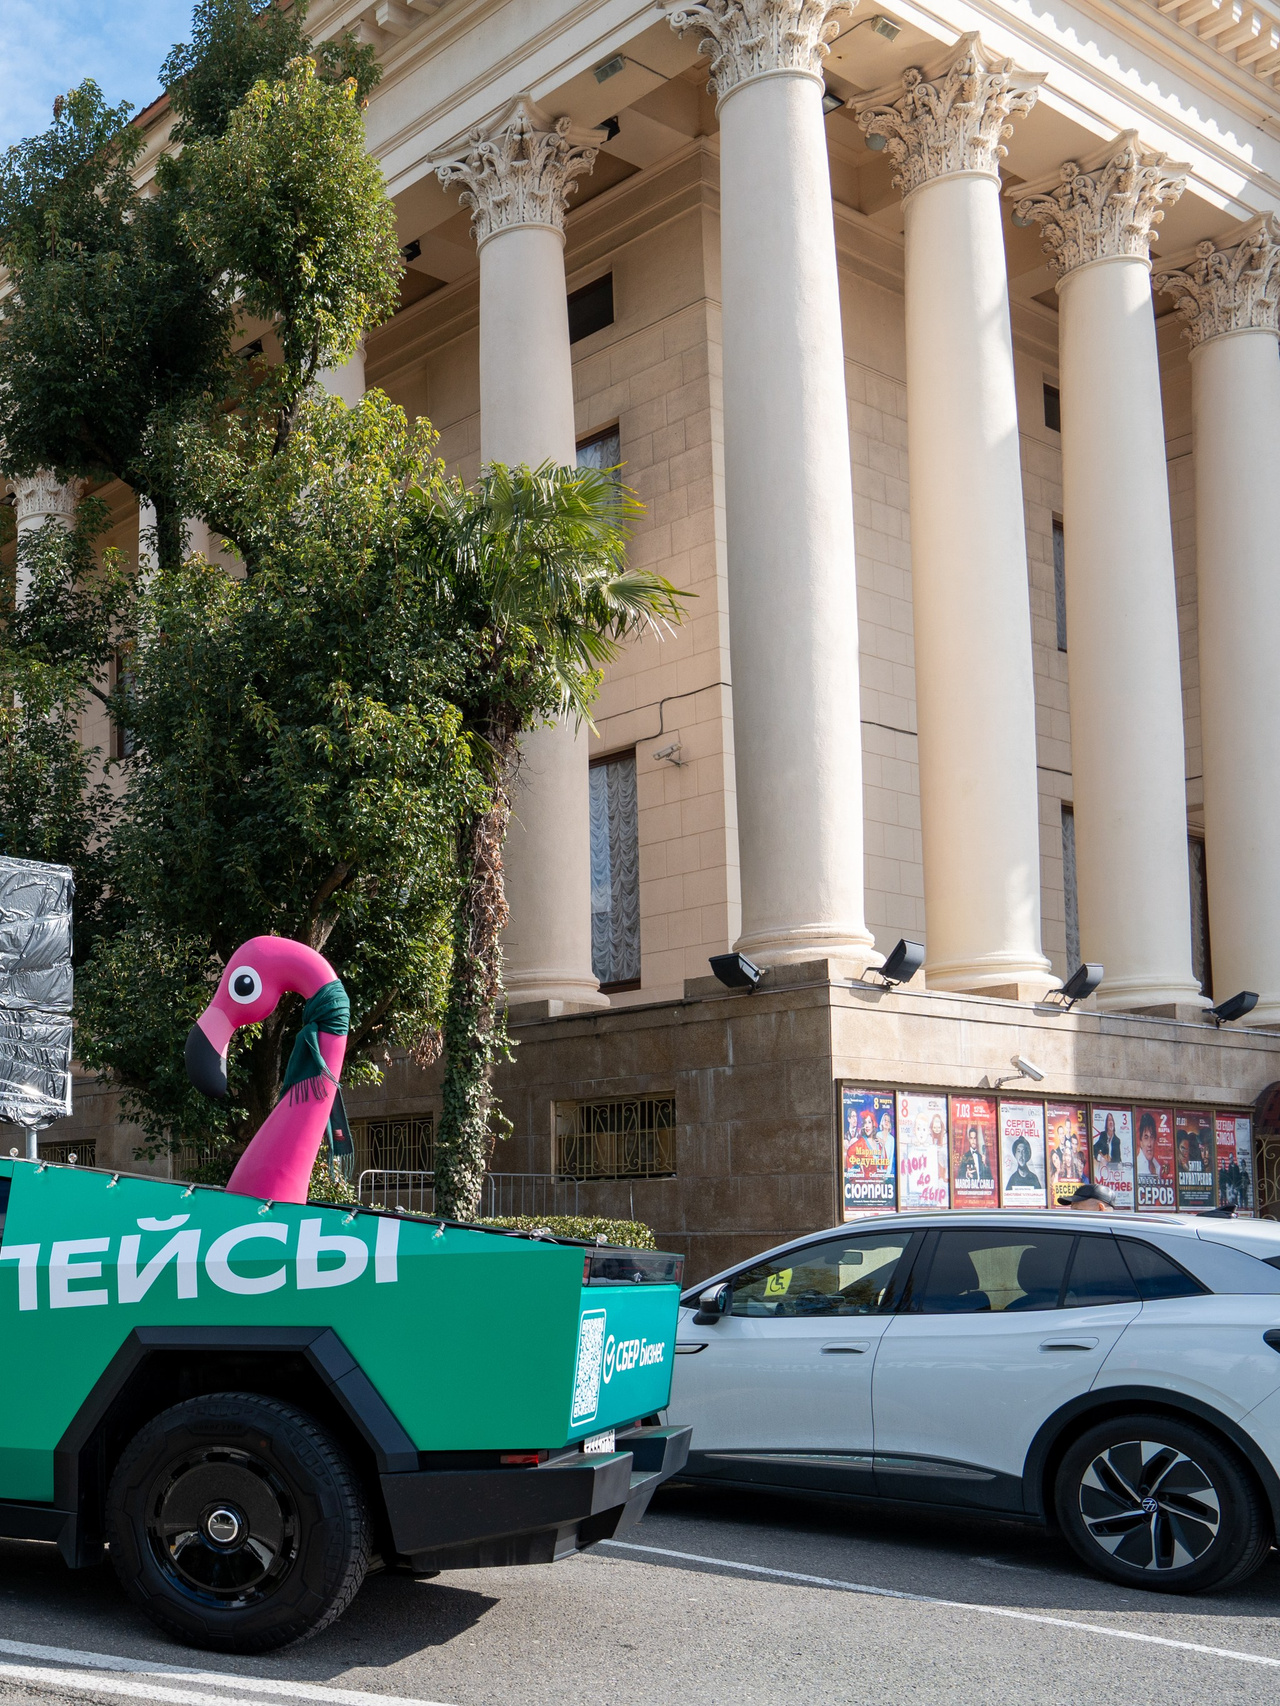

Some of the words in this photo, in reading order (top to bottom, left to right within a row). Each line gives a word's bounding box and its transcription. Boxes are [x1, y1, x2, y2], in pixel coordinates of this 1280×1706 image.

[874, 1098, 880, 1110] 8
[902, 1099, 909, 1118] 8
[956, 1104, 971, 1118] 7.03
[1078, 1111, 1084, 1122] 5
[1123, 1114, 1128, 1125] 3
[1160, 1114, 1168, 1128] 2
[1007, 1120, 1037, 1129] СЕРГЕЙ
[1005, 1129, 1040, 1138] БОБУНЕЦ
[845, 1184, 894, 1199] СЮРПРИЗ
[920, 1187, 946, 1204] ДЫР
[1139, 1187, 1174, 1205] СЕРОВ
[615, 1339, 640, 1372] СБЕР
[639, 1338, 665, 1367] Бизнес
